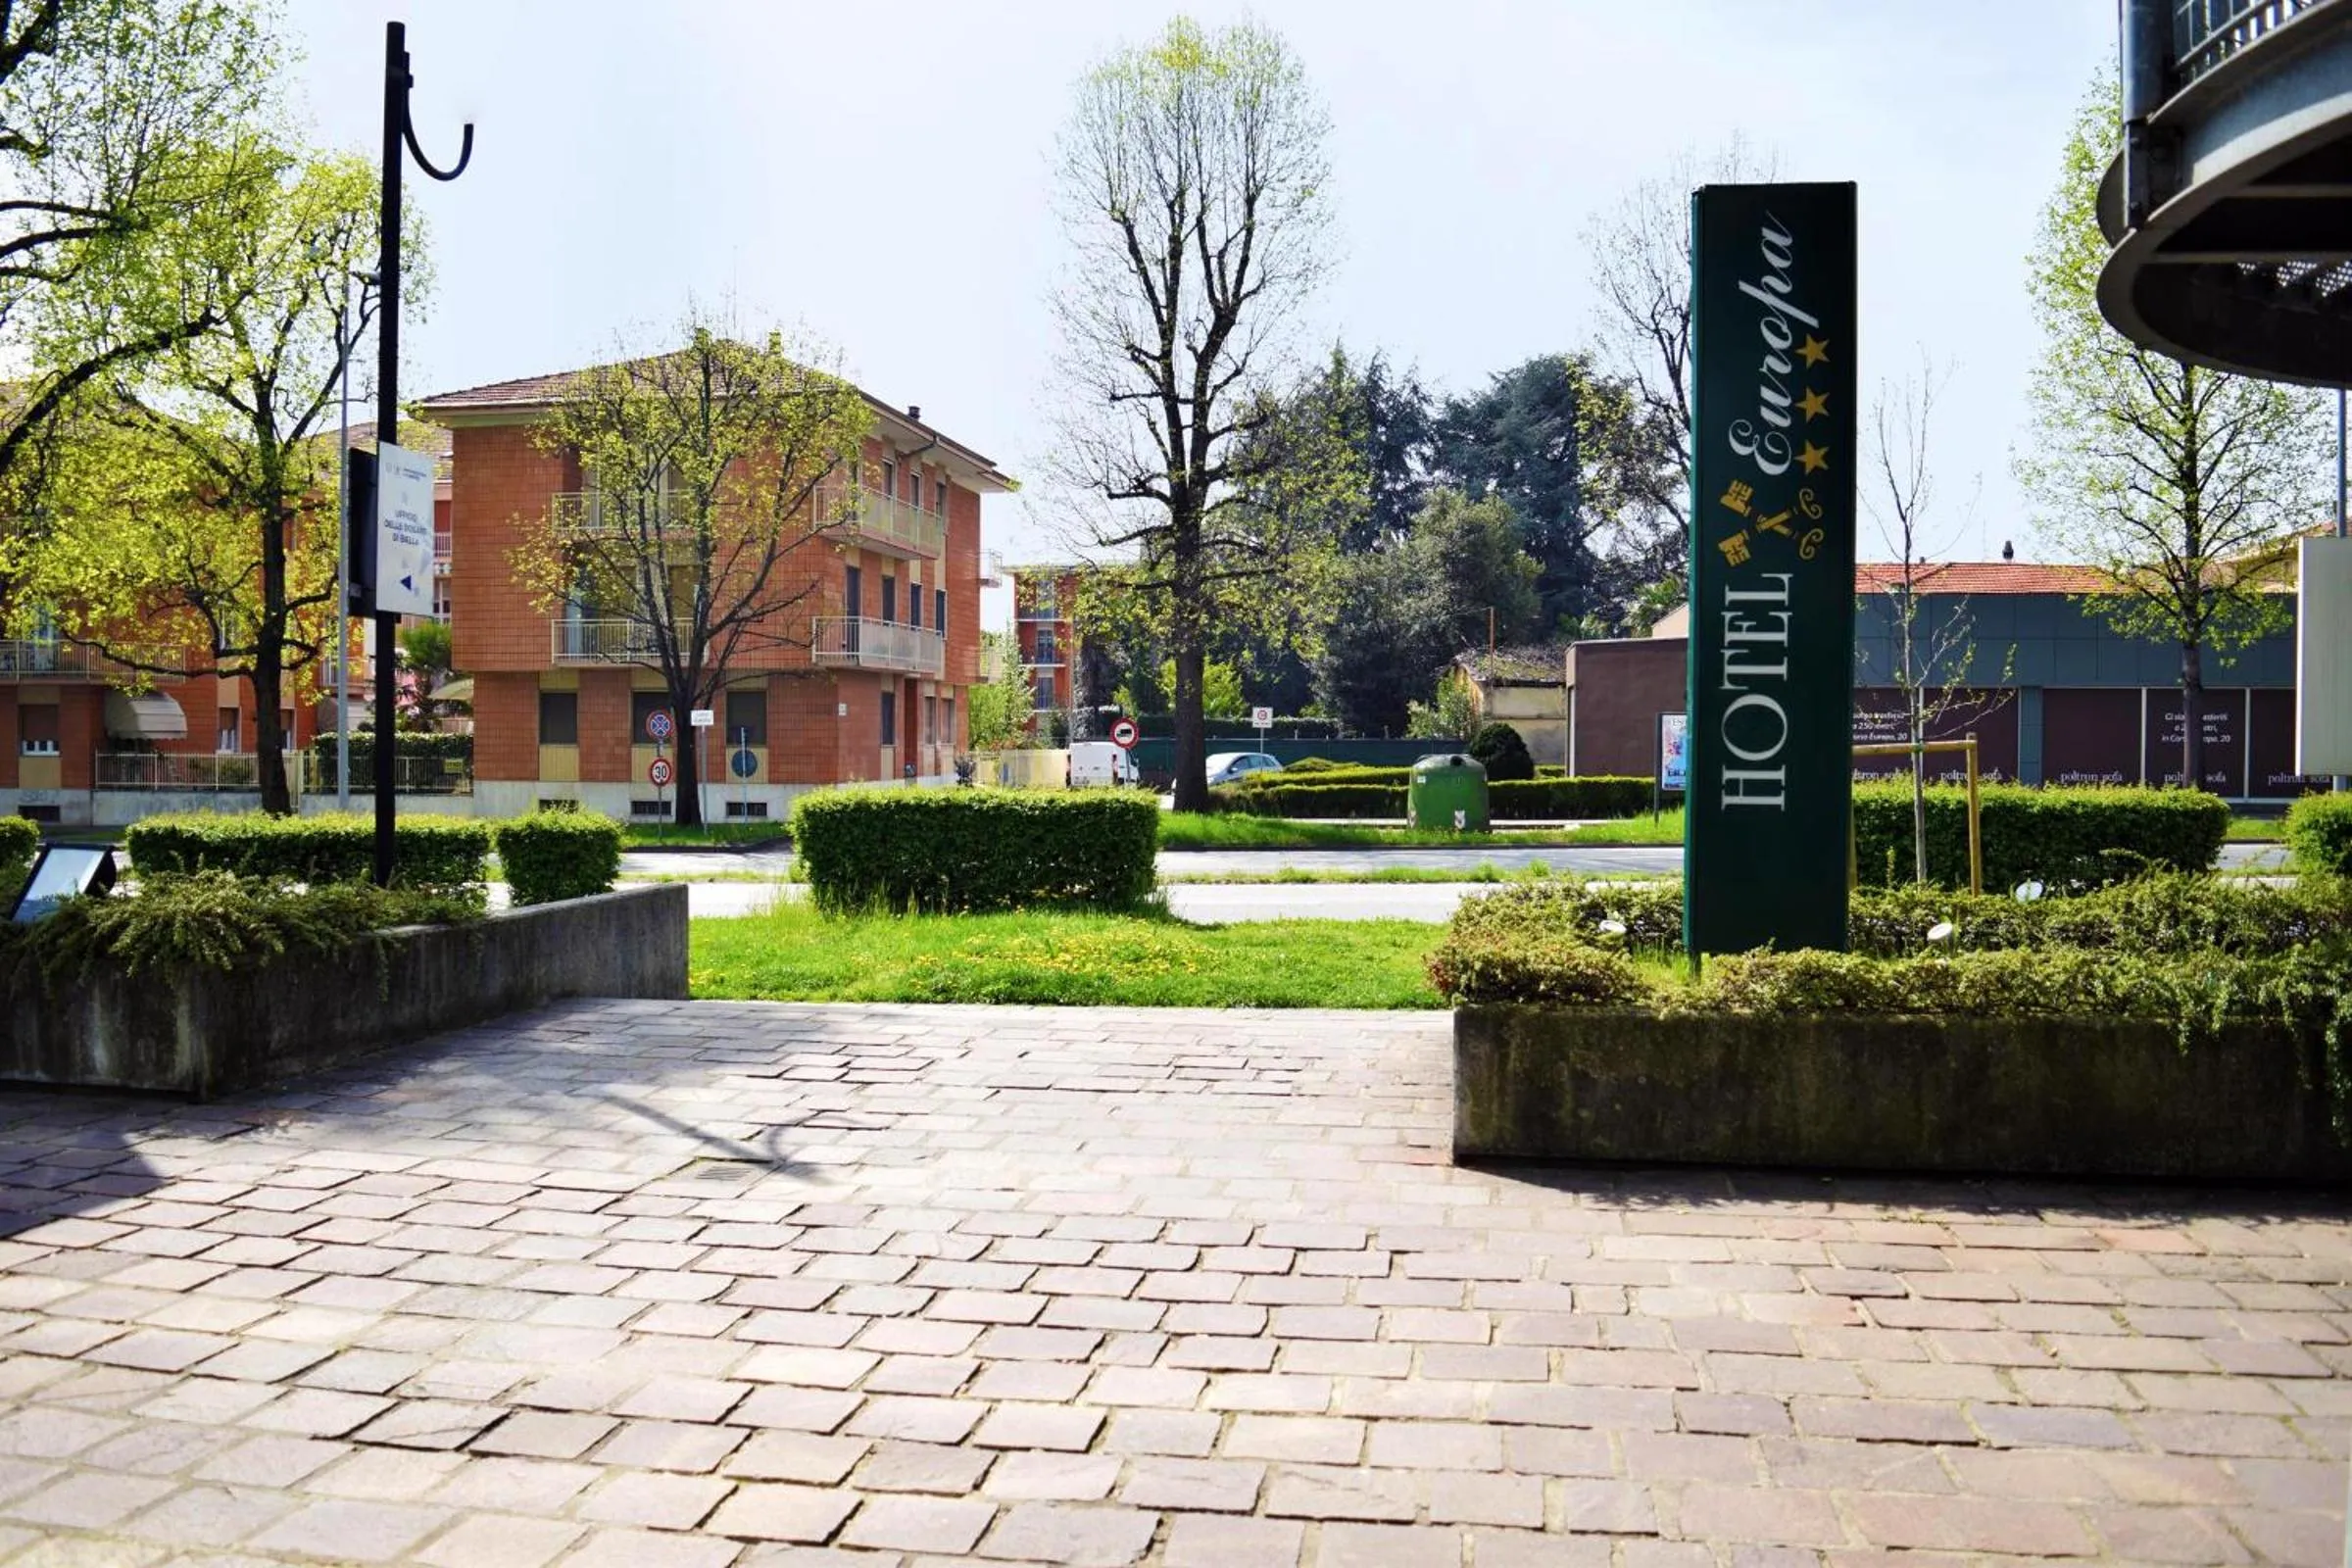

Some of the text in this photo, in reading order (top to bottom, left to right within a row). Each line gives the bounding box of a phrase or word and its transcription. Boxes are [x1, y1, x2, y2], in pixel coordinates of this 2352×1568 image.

[1719, 209, 1820, 811] HOTEL Europa
[655, 765, 667, 779] 30
